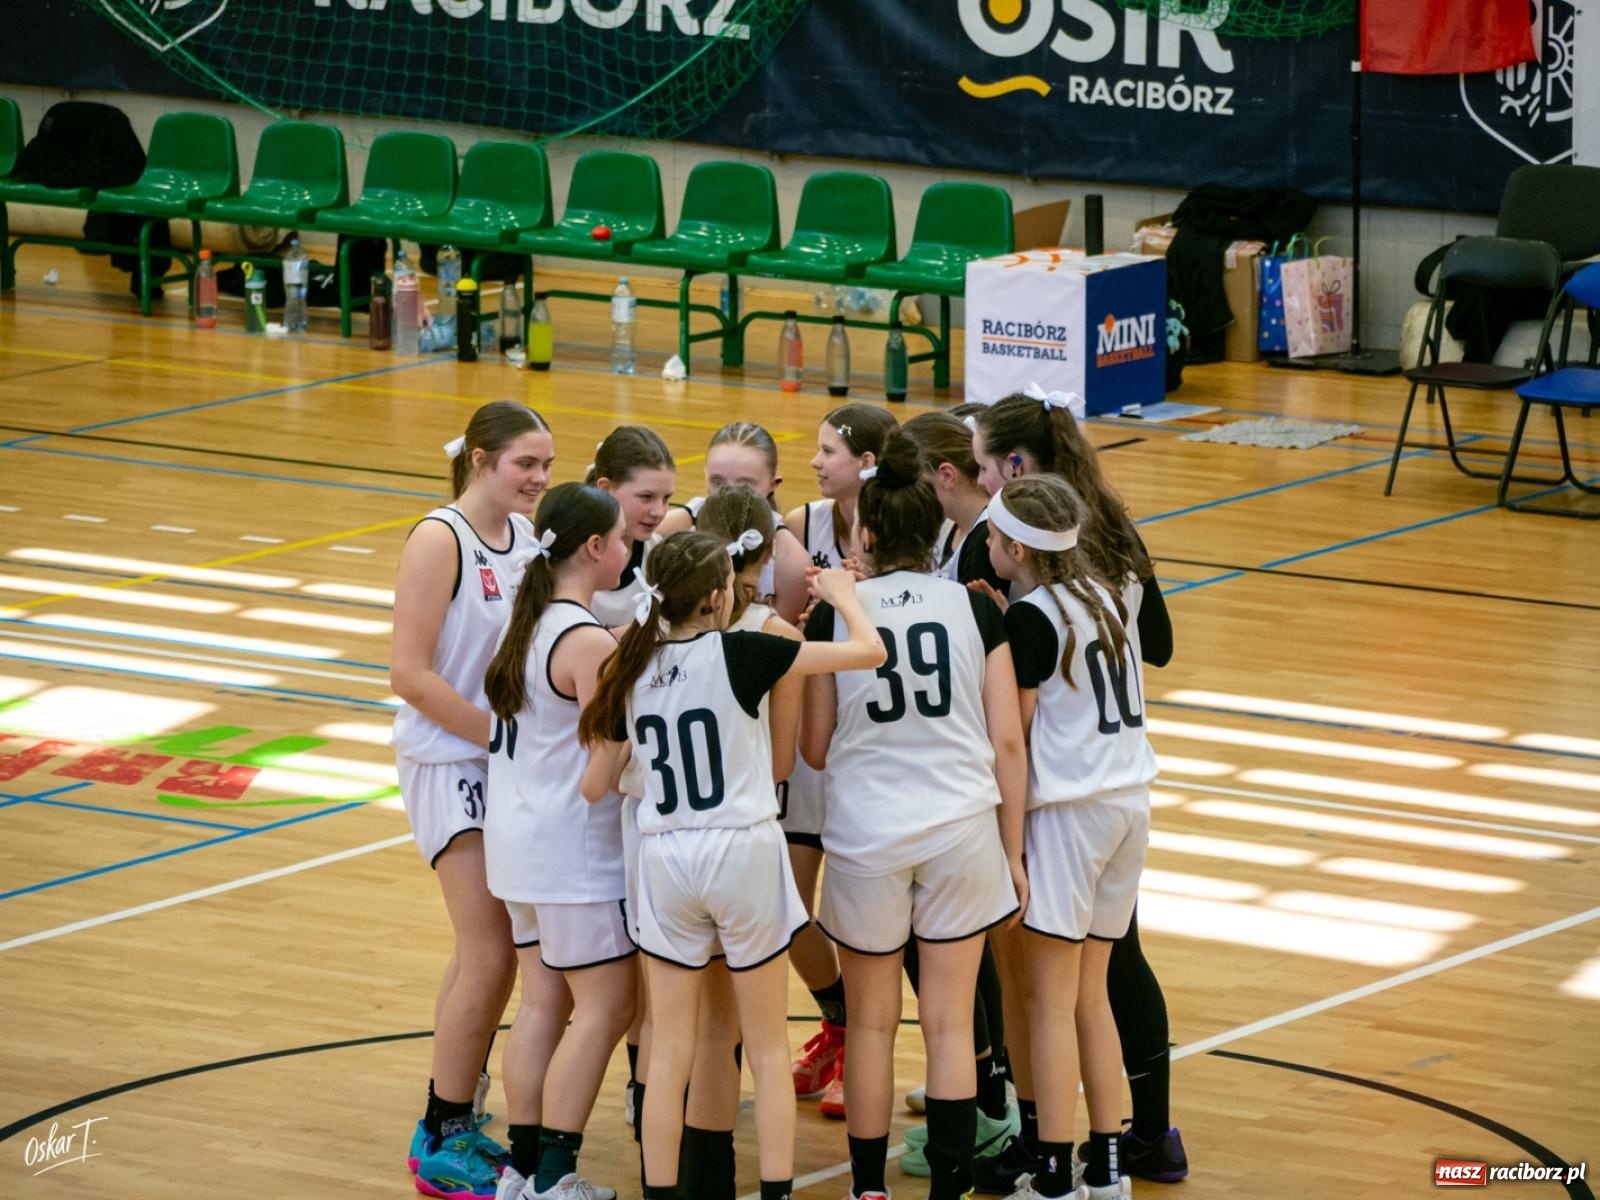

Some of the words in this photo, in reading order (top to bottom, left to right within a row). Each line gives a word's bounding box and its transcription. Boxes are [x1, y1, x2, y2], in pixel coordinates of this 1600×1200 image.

[1068, 75, 1234, 115] RACIBÓRZ
[982, 319, 1067, 342] RACIBÓRZ
[982, 342, 1068, 361] BASKETBALL
[1096, 313, 1156, 355] MINI
[866, 622, 951, 723] 39
[635, 708, 724, 815] 30
[458, 778, 486, 821] 31
